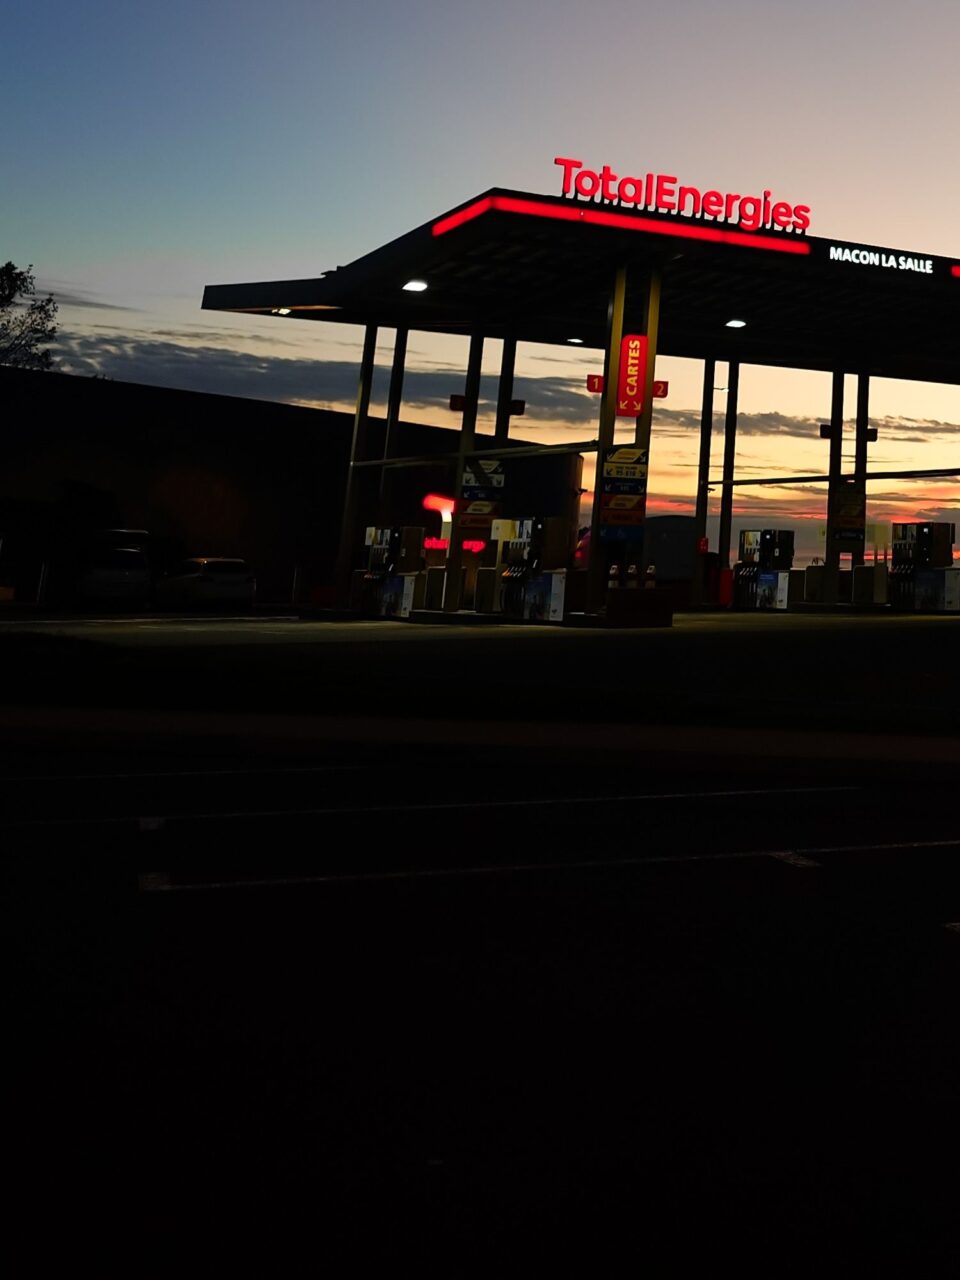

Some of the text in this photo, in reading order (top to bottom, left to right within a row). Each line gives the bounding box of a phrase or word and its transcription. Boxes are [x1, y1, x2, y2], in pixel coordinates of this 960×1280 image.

[554, 158, 811, 232] TotalEnergies
[829, 246, 933, 274] MACON LA SALLE
[626, 339, 641, 397] CARTES
[656, 383, 665, 396] 2
